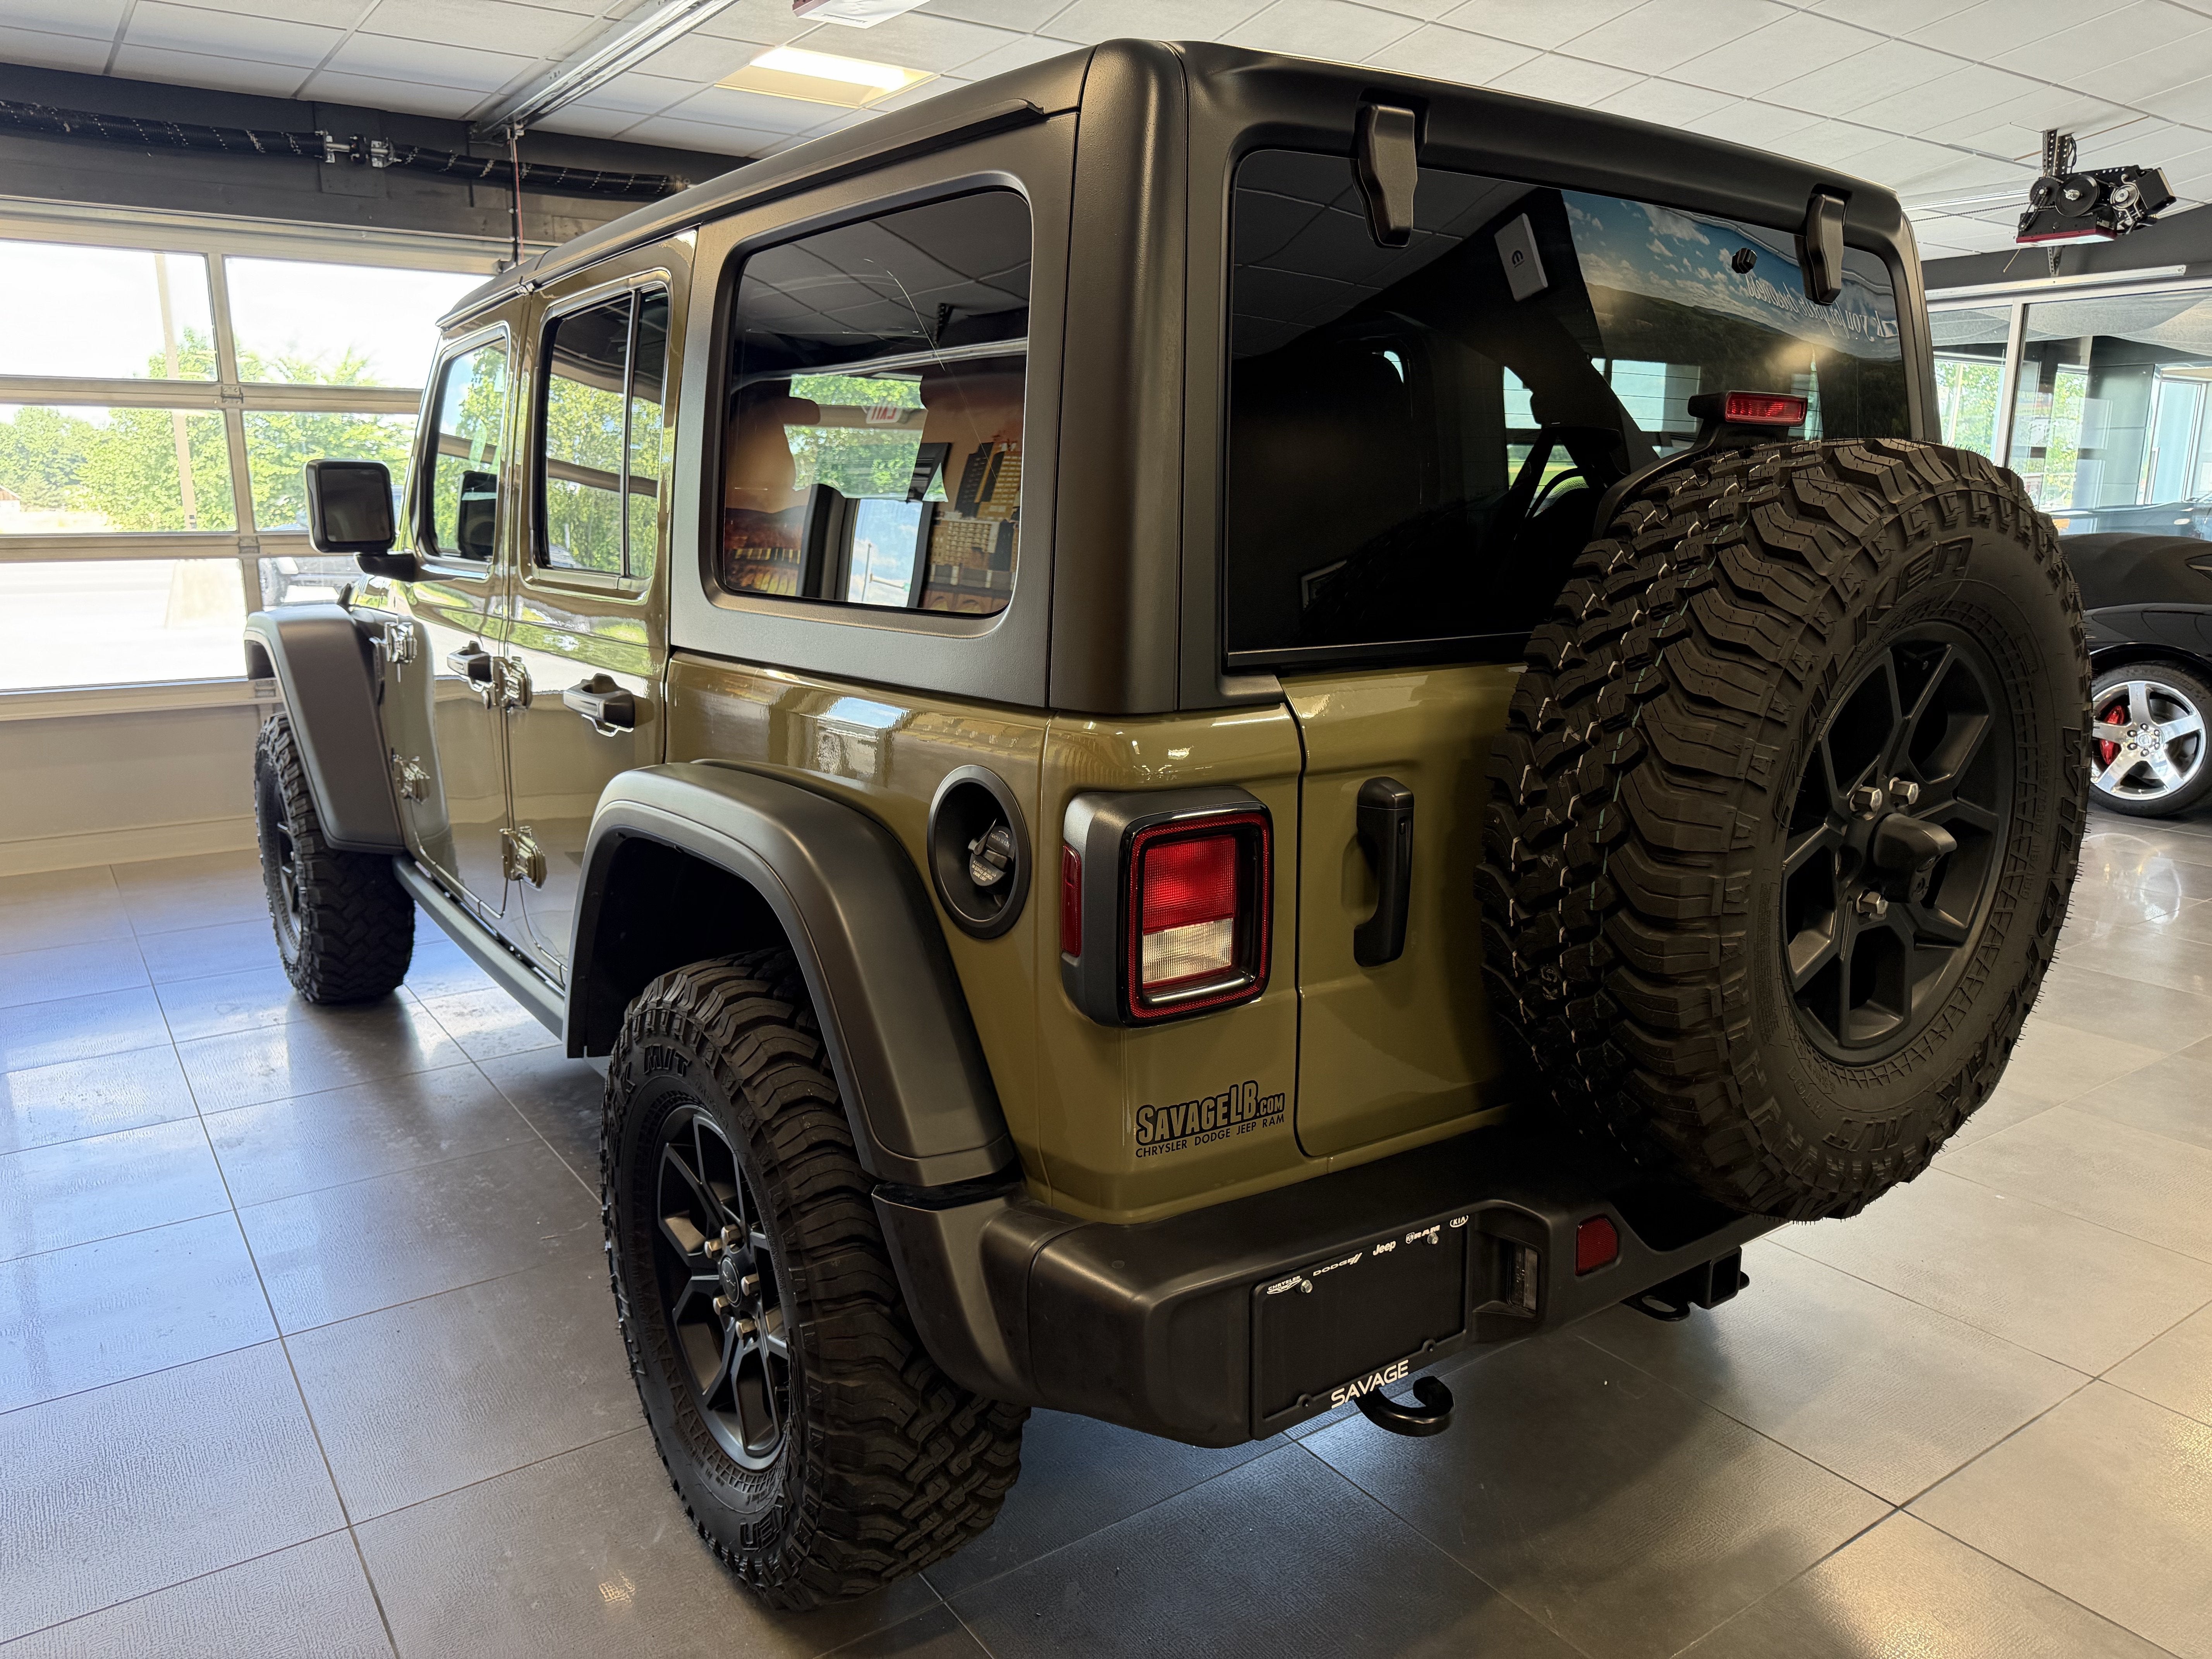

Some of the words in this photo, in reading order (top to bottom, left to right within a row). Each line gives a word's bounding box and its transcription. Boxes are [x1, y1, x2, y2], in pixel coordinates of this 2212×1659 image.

[1135, 1139, 1188, 1158] CHRYSLER
[1194, 1128, 1231, 1146] DODGE
[1236, 1121, 1257, 1135] JEEP
[1262, 1113, 1285, 1128] RAM
[1268, 1275, 1300, 1291] CHRYSLER
[1313, 1256, 1355, 1276] DODGE
[1372, 1240, 1396, 1256] Jeep
[1414, 1224, 1441, 1240] RAM
[1452, 1216, 1467, 1226] KIA
[1330, 1359, 1409, 1409] SAVAGE
